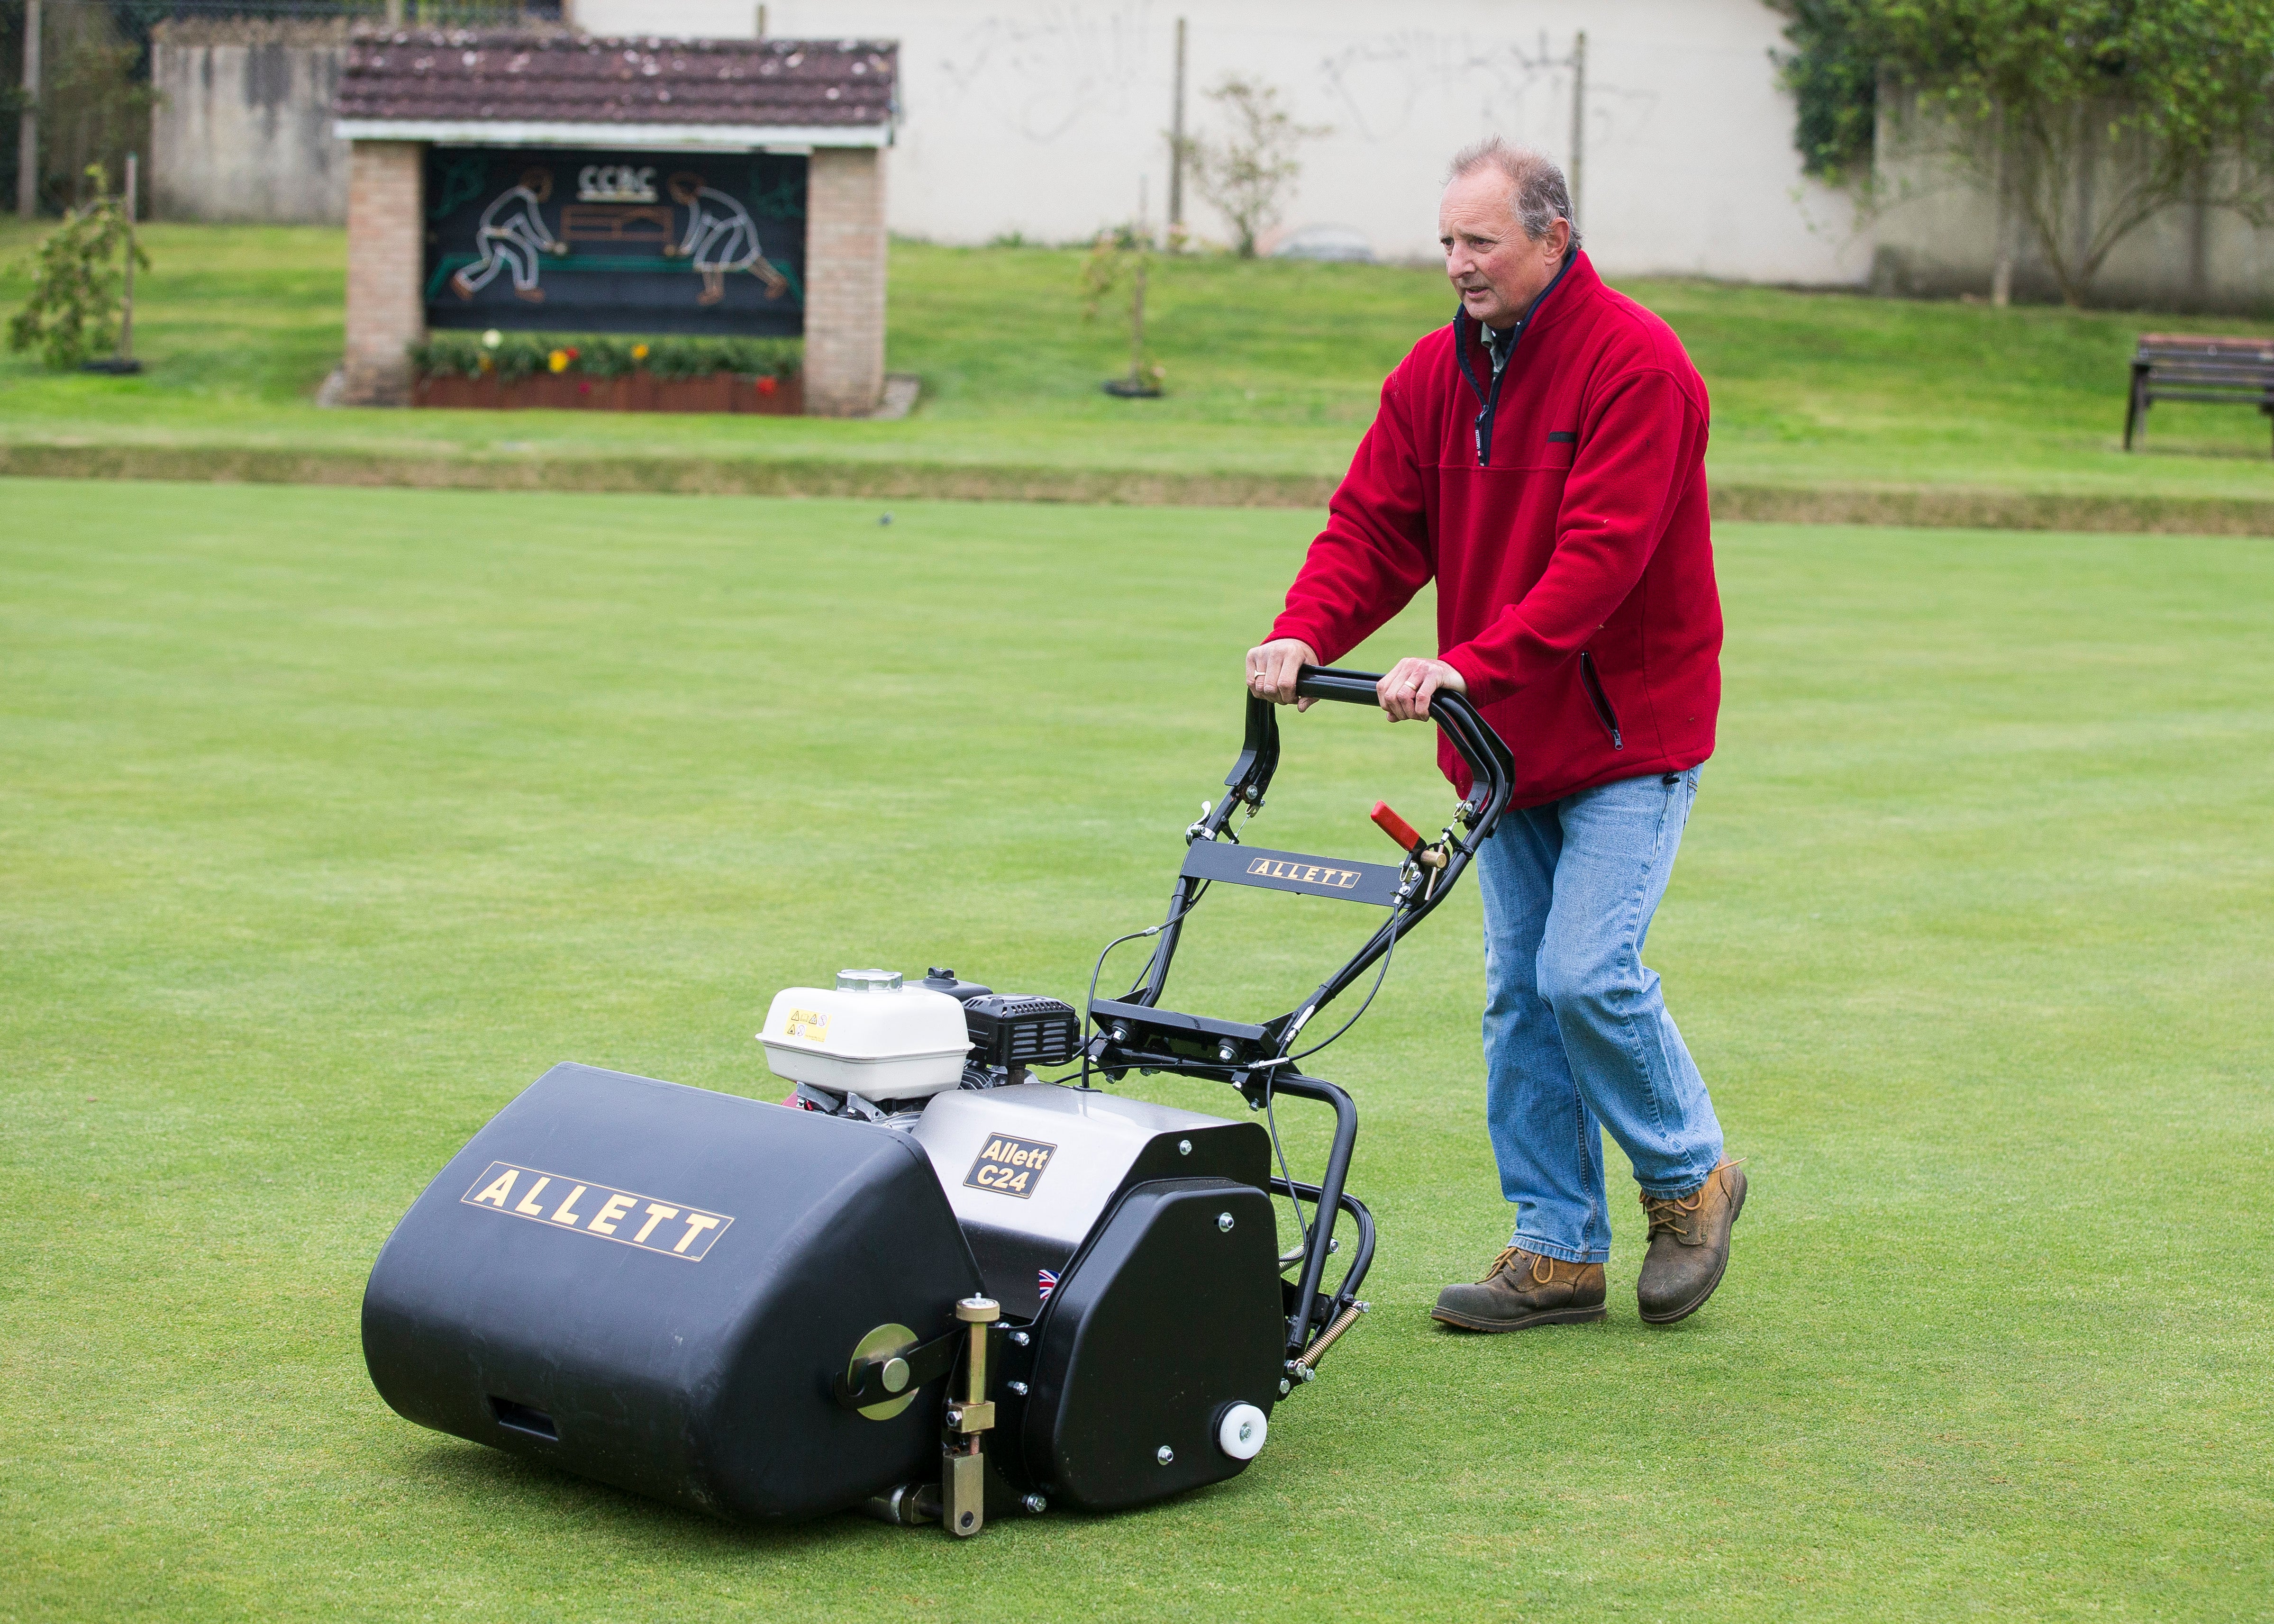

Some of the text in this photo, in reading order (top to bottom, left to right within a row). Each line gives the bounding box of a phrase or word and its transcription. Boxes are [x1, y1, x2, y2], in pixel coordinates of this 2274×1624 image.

[1254, 861, 1353, 886] ALLETT
[980, 1139, 1049, 1170] Allett
[976, 1164, 1030, 1192] C24
[473, 1169, 720, 1253] ALLETT
